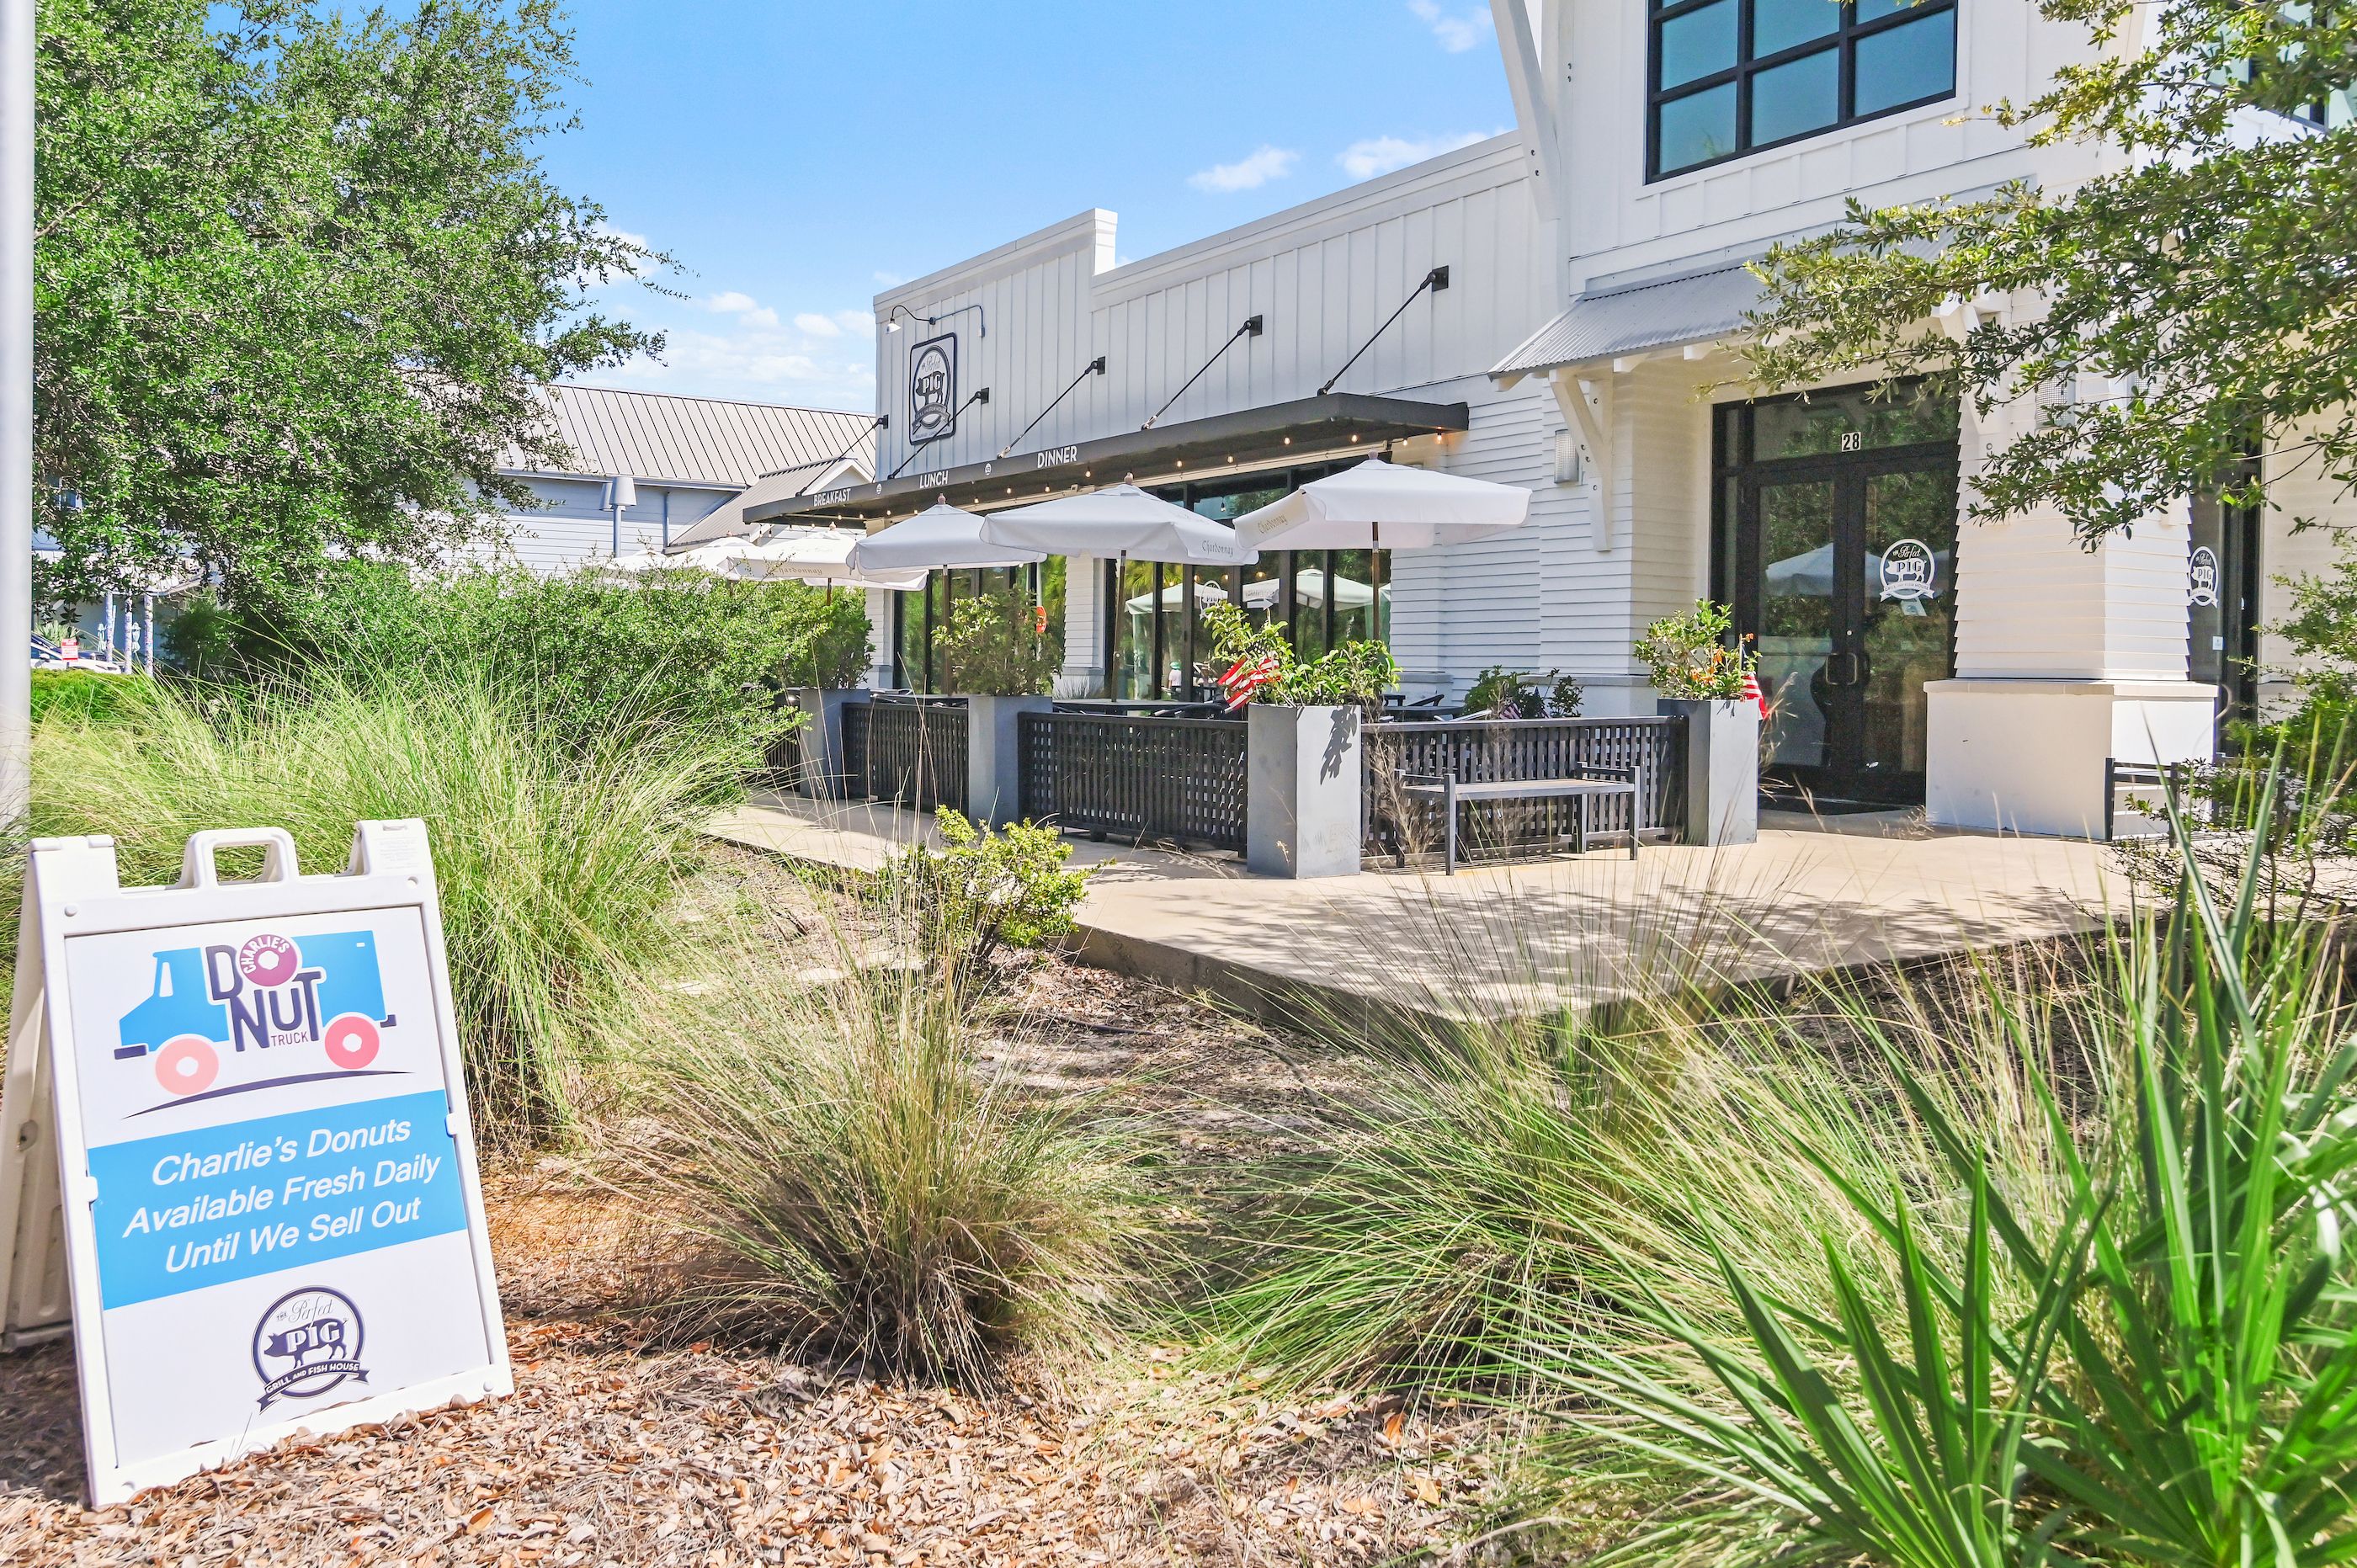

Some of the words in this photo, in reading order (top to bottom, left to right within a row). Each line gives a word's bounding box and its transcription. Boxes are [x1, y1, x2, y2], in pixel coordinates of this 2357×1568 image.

[922, 375, 942, 394] PIG
[1843, 433, 1860, 450] 28
[1037, 445, 1077, 469] DINNER
[919, 470, 949, 489] LUNCH
[813, 488, 851, 507] BREAKFAST
[1202, 540, 1234, 558] Chardonnay
[1897, 561, 1922, 572] PIG
[2198, 569, 2211, 580] PIG
[240, 936, 290, 974] CHARLIE'S
[271, 1031, 309, 1046] TRUCK
[152, 1135, 299, 1186] Charlie's
[306, 1119, 411, 1158] Donuts
[122, 1186, 274, 1238] Available
[282, 1167, 365, 1205] Fresh
[374, 1153, 441, 1188] Daily
[165, 1231, 241, 1273] Until
[251, 1222, 300, 1255] We
[308, 1205, 363, 1242] Sell
[371, 1196, 422, 1228] Out
[288, 1296, 334, 1324] Perfect
[287, 1321, 341, 1353] PIG
[265, 1376, 292, 1394] GRILL
[292, 1369, 306, 1379] AND
[307, 1363, 328, 1375] FISH
[329, 1362, 359, 1371] HOUSE
